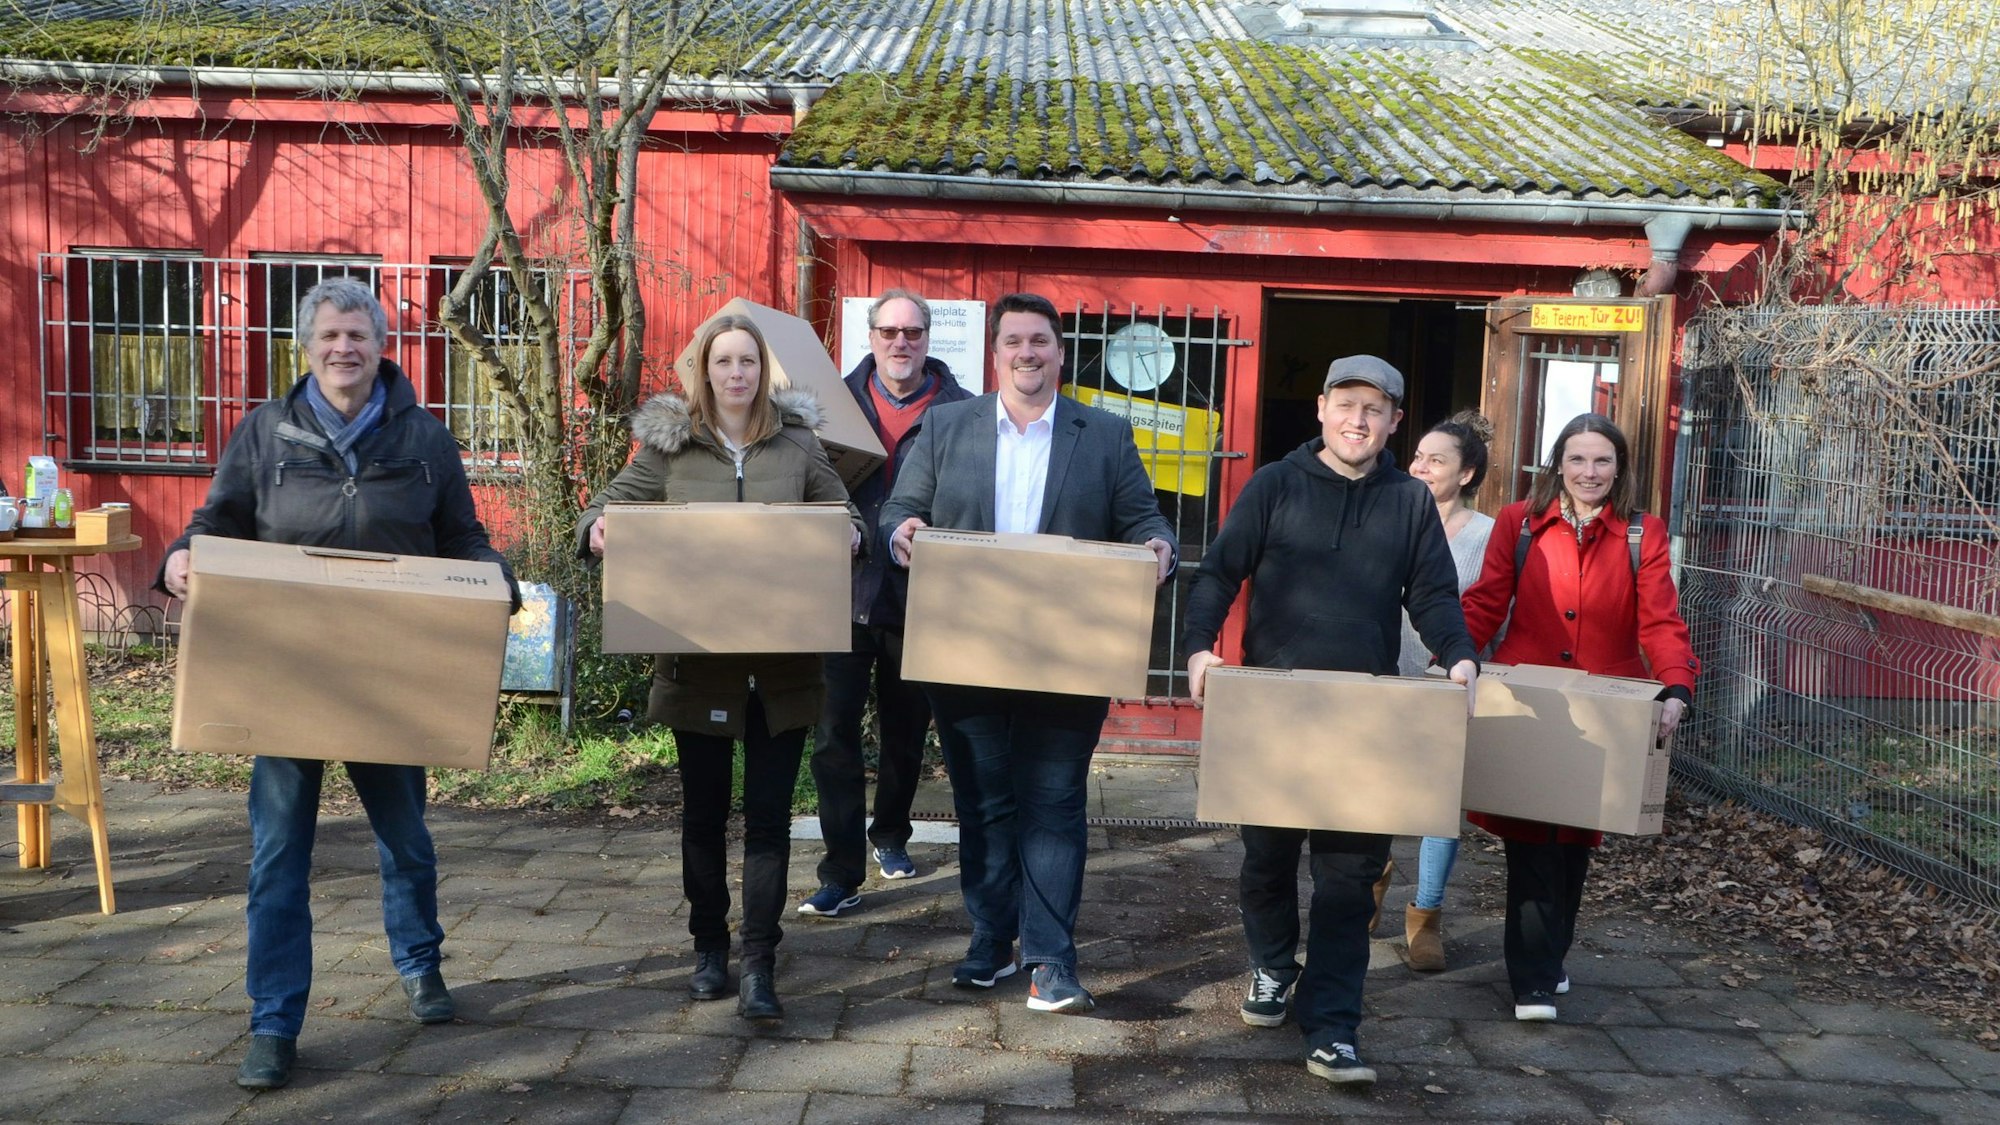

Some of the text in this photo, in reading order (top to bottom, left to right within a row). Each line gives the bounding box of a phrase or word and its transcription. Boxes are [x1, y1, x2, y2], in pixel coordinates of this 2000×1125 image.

[931, 306, 967, 318] ielplatz
[1533, 307, 1548, 326] Bei
[1590, 307, 1609, 323] Tür
[1614, 308, 1640, 323] ZU!
[930, 319, 967, 328] ms-Hütte
[444, 575, 488, 586] Hier
